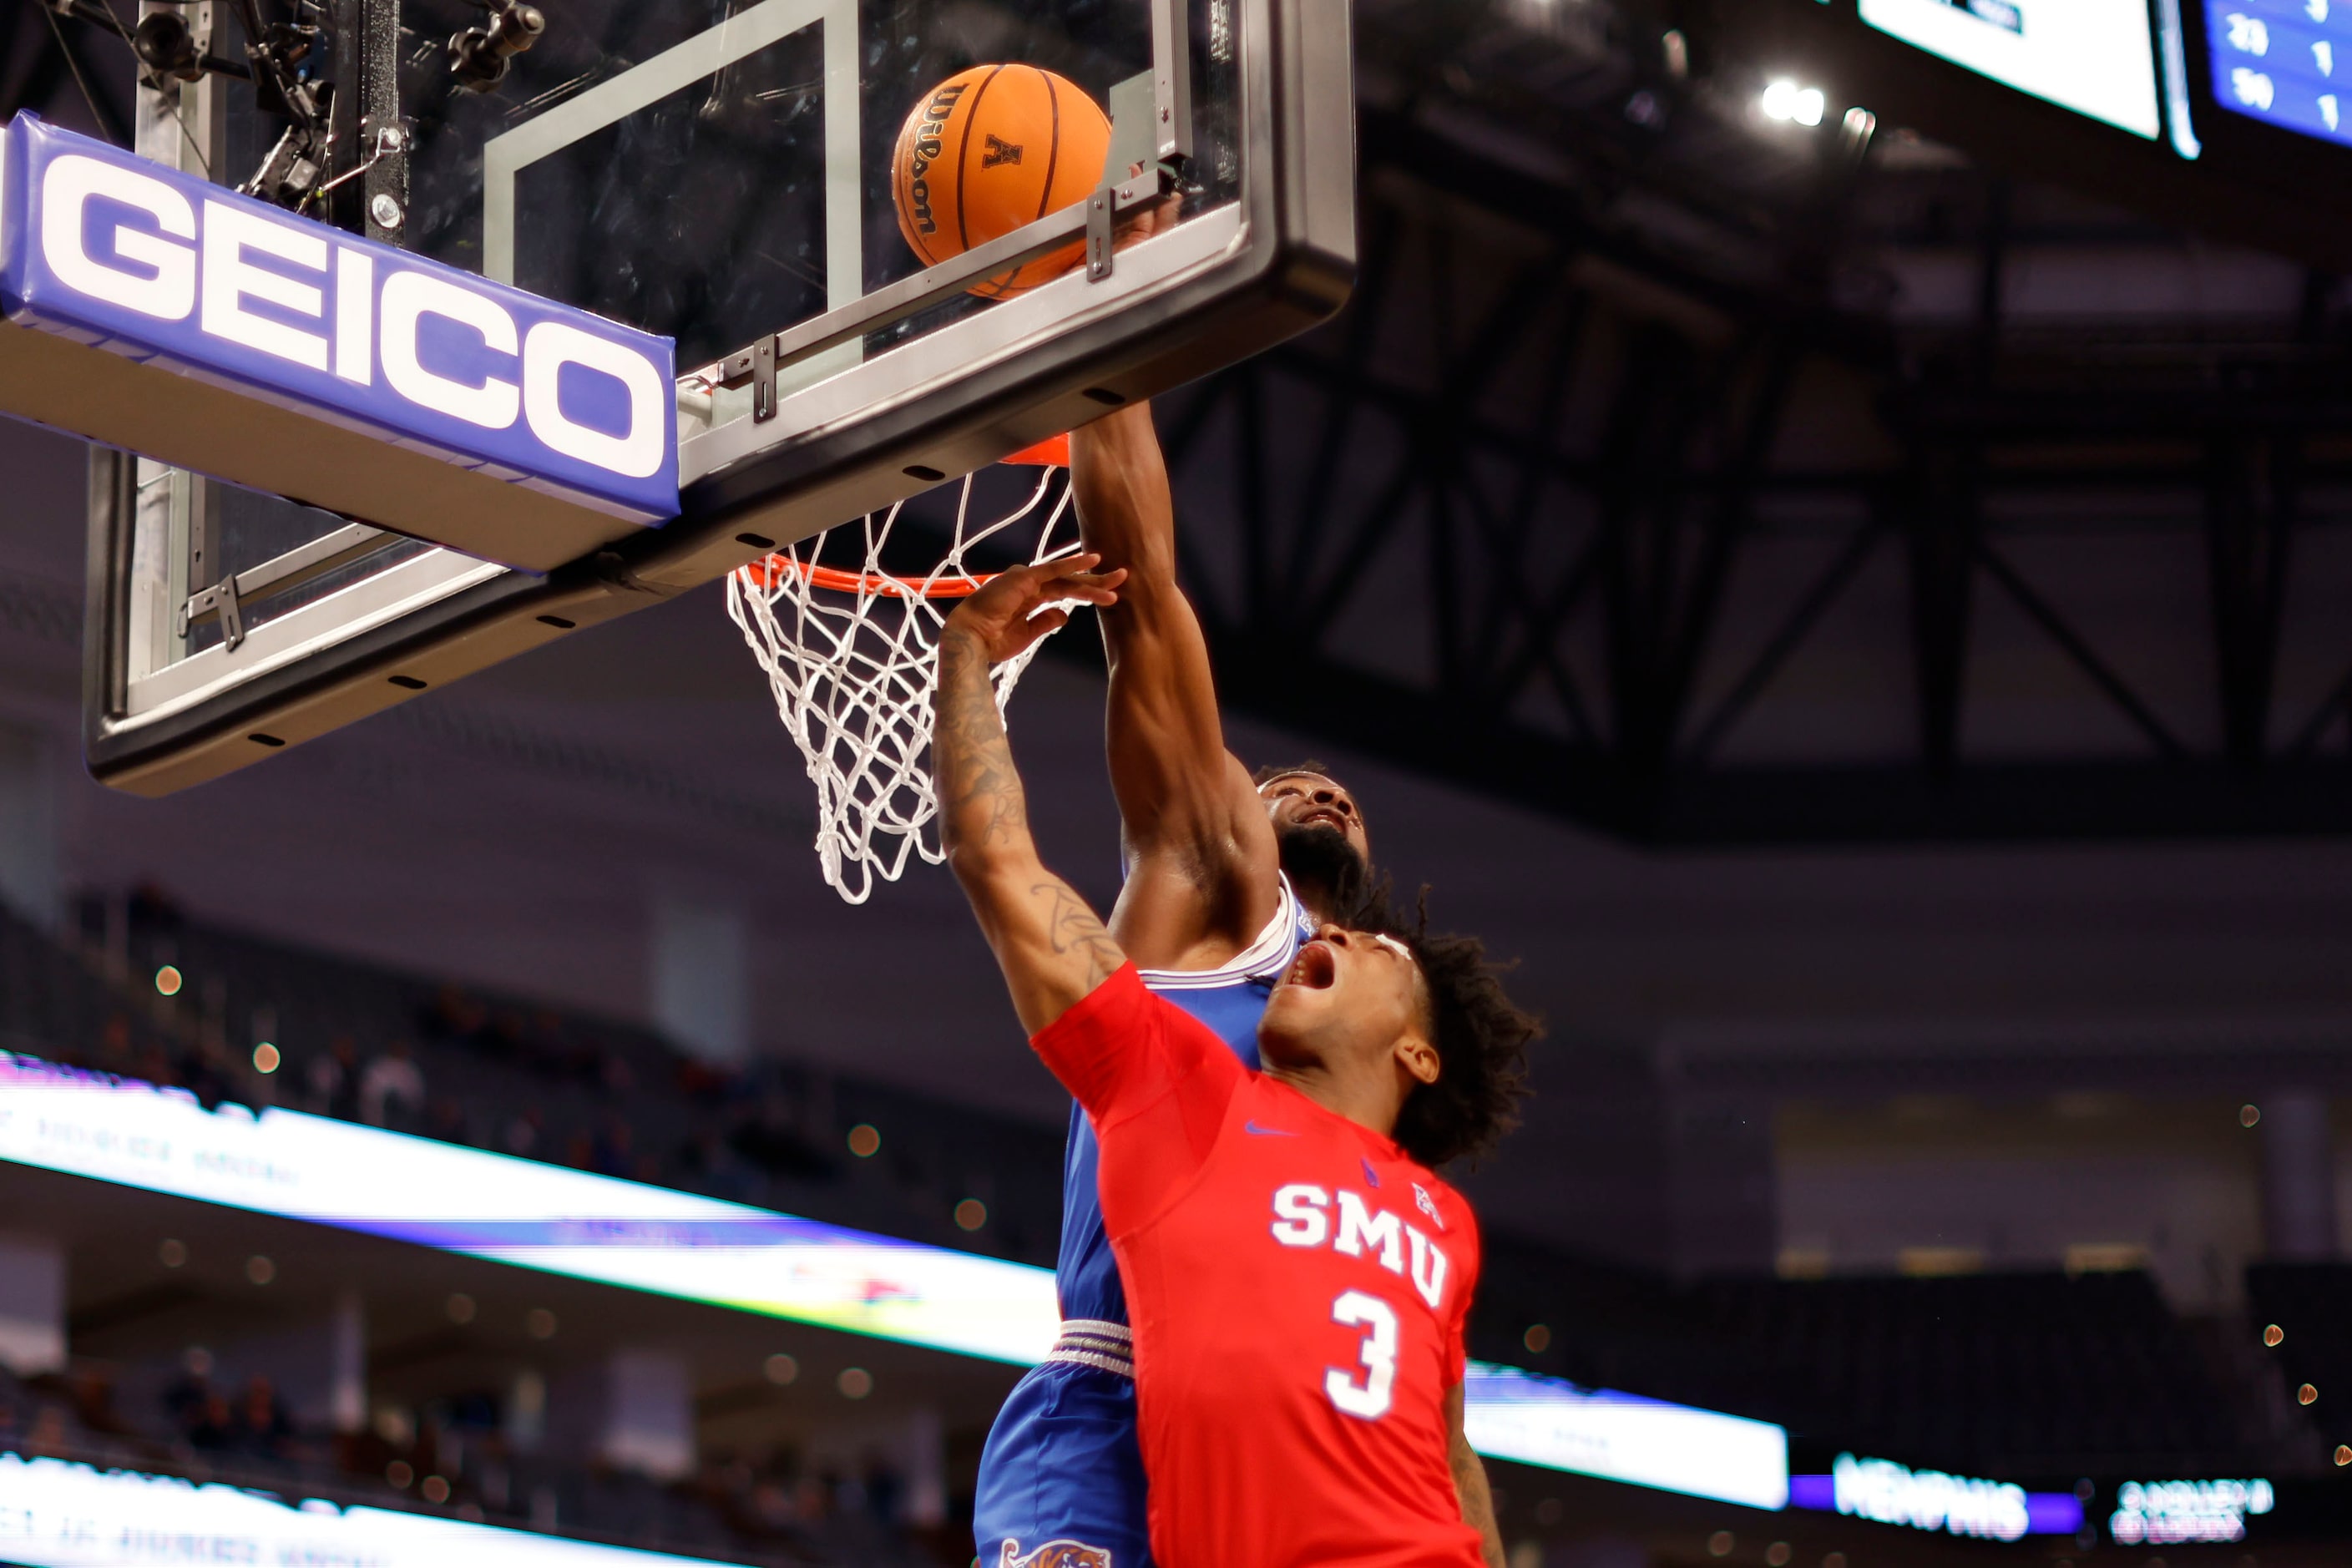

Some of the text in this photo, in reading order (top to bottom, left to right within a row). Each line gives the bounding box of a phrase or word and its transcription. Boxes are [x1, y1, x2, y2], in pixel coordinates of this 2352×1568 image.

[911, 83, 969, 235] Wilson
[42, 154, 665, 478] GEICO
[1270, 1181, 1449, 1309] SMU
[1323, 1288, 1399, 1422] 3
